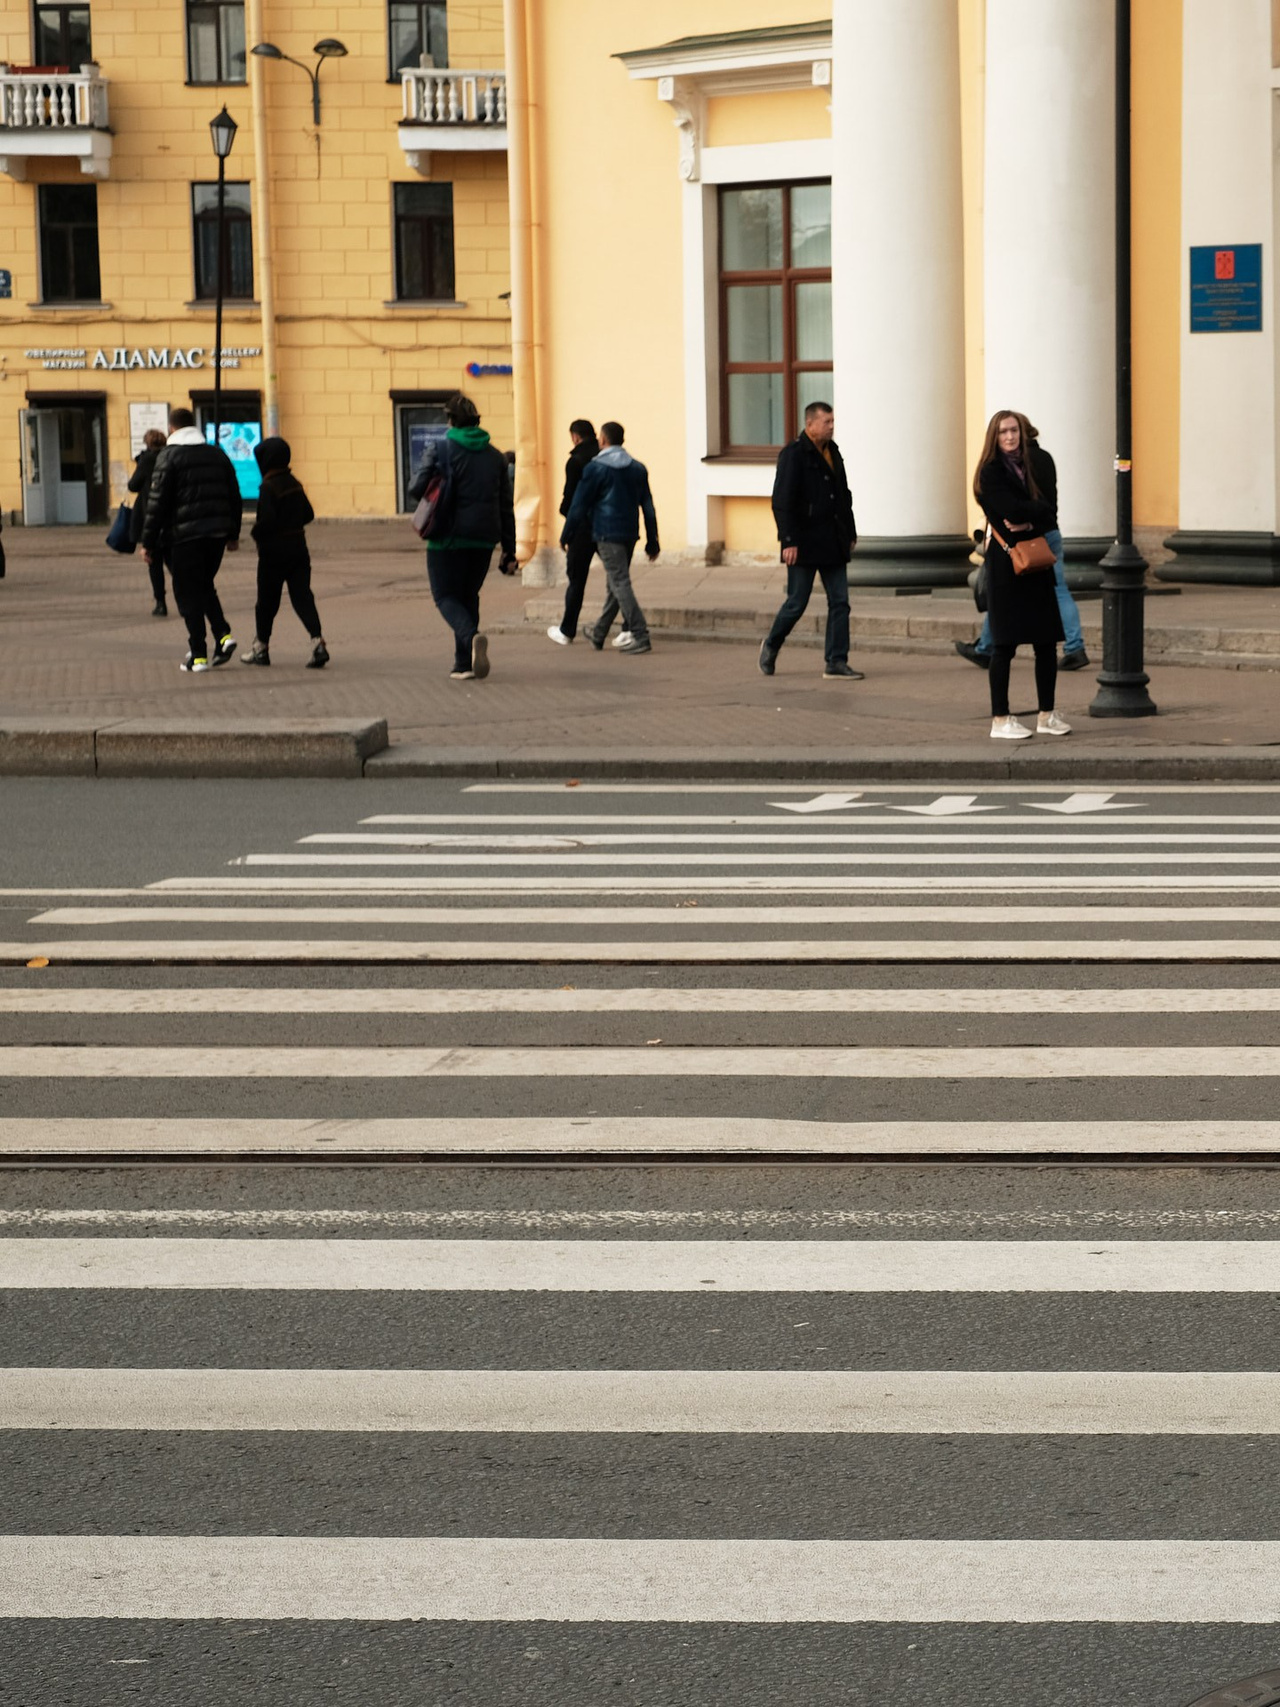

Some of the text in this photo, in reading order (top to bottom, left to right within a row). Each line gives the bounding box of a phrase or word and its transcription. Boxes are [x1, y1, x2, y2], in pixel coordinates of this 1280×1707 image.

[210, 348, 262, 357] JWELLERY
[93, 347, 203, 371] АДАМАС
[210, 359, 239, 368] SORE
[42, 360, 86, 369] МАГАЗИН
